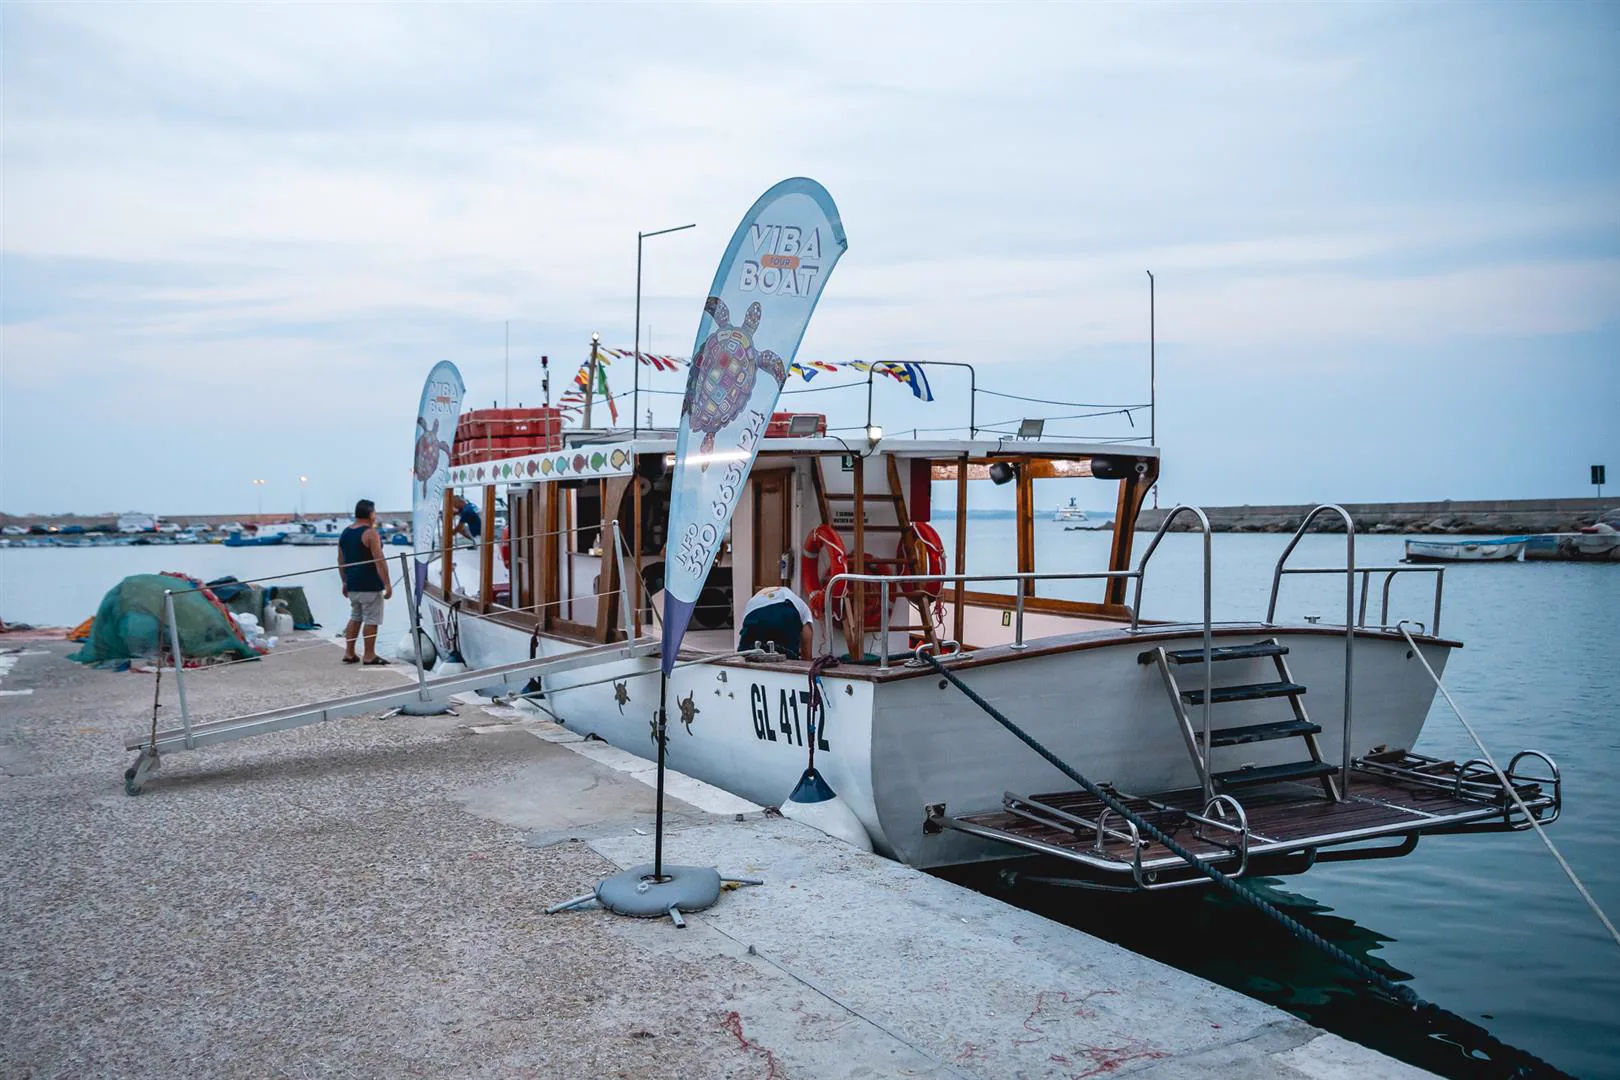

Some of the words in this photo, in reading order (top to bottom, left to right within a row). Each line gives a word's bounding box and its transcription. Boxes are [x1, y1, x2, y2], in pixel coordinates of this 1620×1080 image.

[751, 224, 821, 260] VIBA
[770, 257, 791, 266] TOUR
[739, 260, 819, 298] BOAT
[675, 522, 699, 570] INFO
[686, 523, 717, 580] 320
[751, 683, 777, 742] GL
